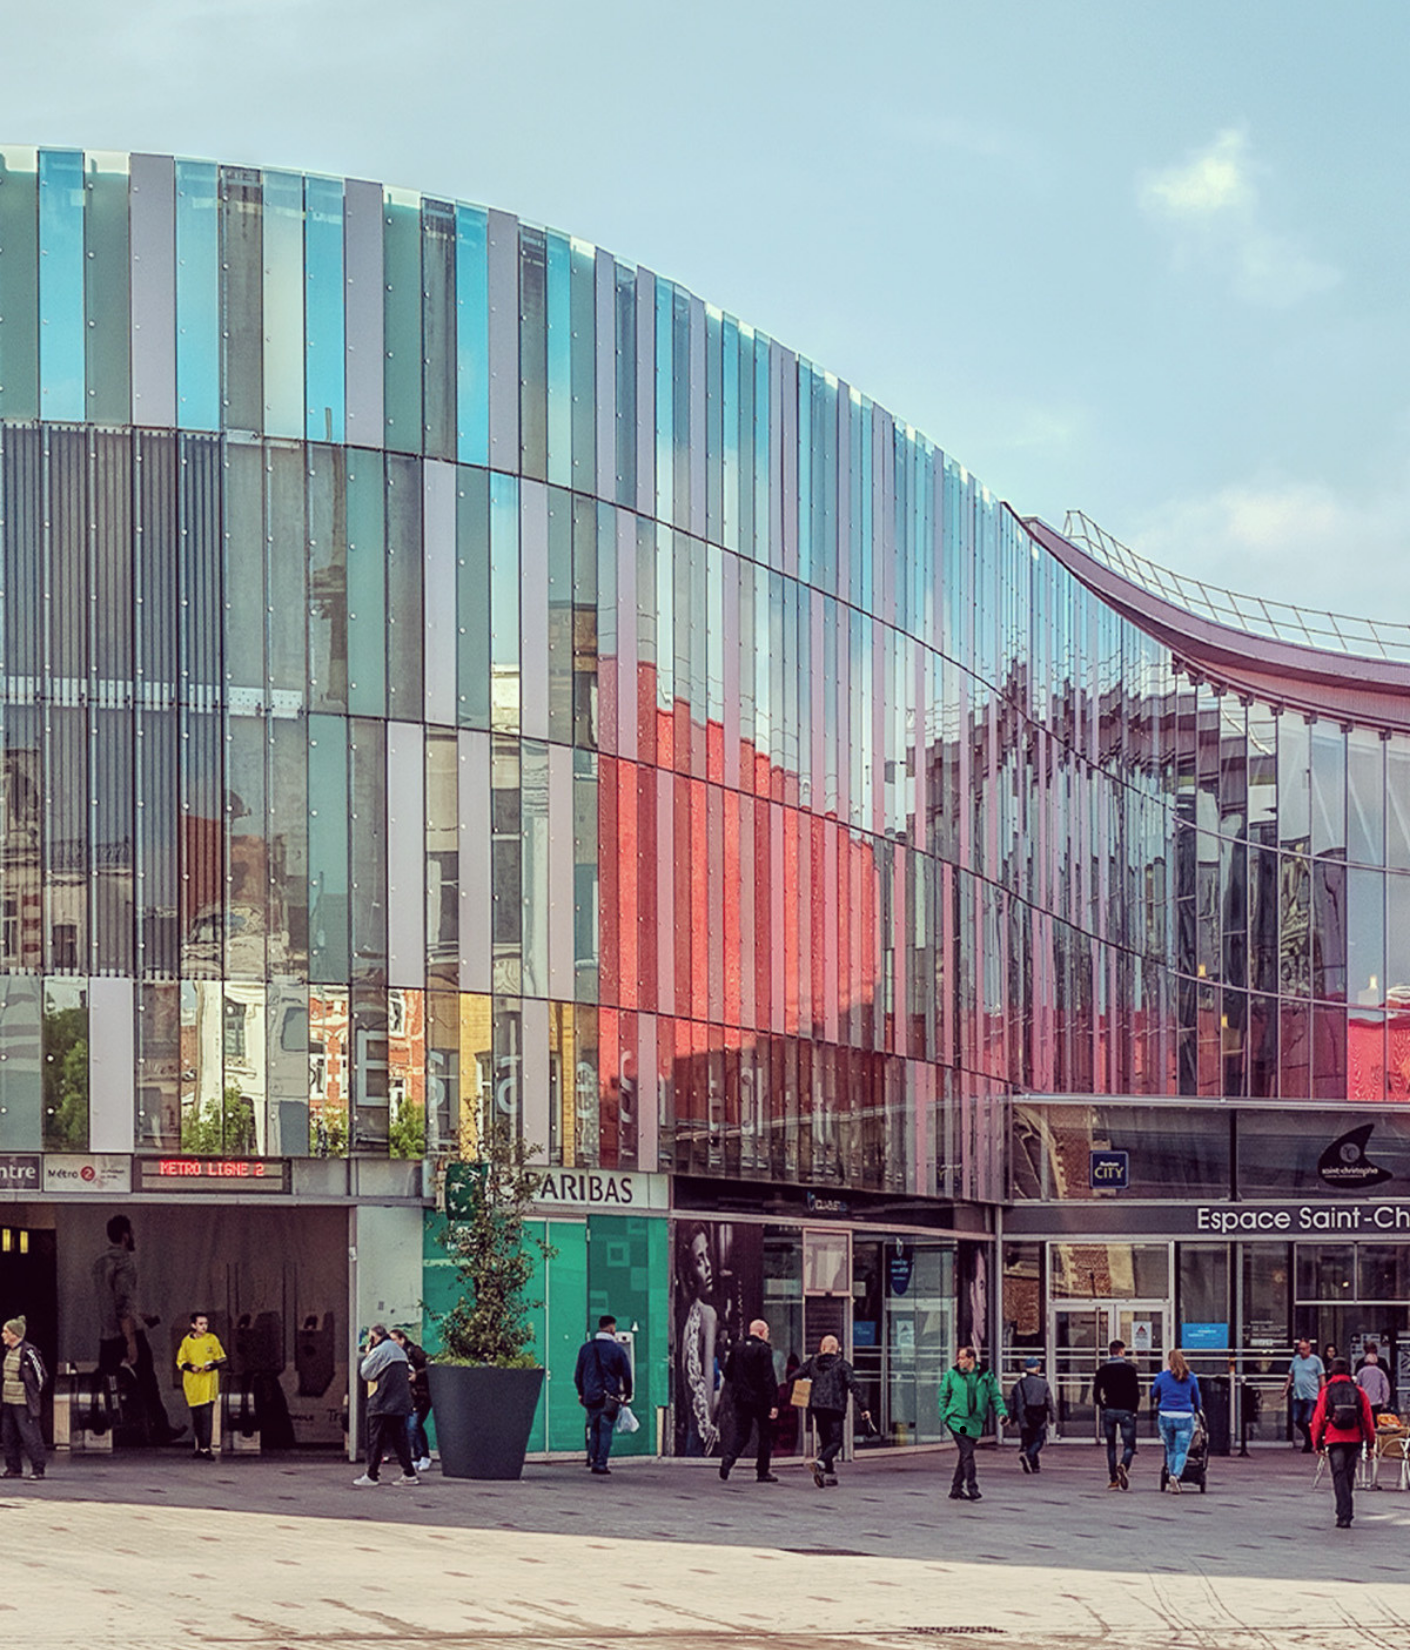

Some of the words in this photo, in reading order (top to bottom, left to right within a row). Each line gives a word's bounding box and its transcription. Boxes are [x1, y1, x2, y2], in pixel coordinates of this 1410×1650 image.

[160, 1161, 202, 1176] METRO
[208, 1161, 249, 1177] LIGNE
[253, 1162, 264, 1177] 2
[1094, 1166, 1124, 1179] CITY
[1197, 1207, 1291, 1233] Espace
